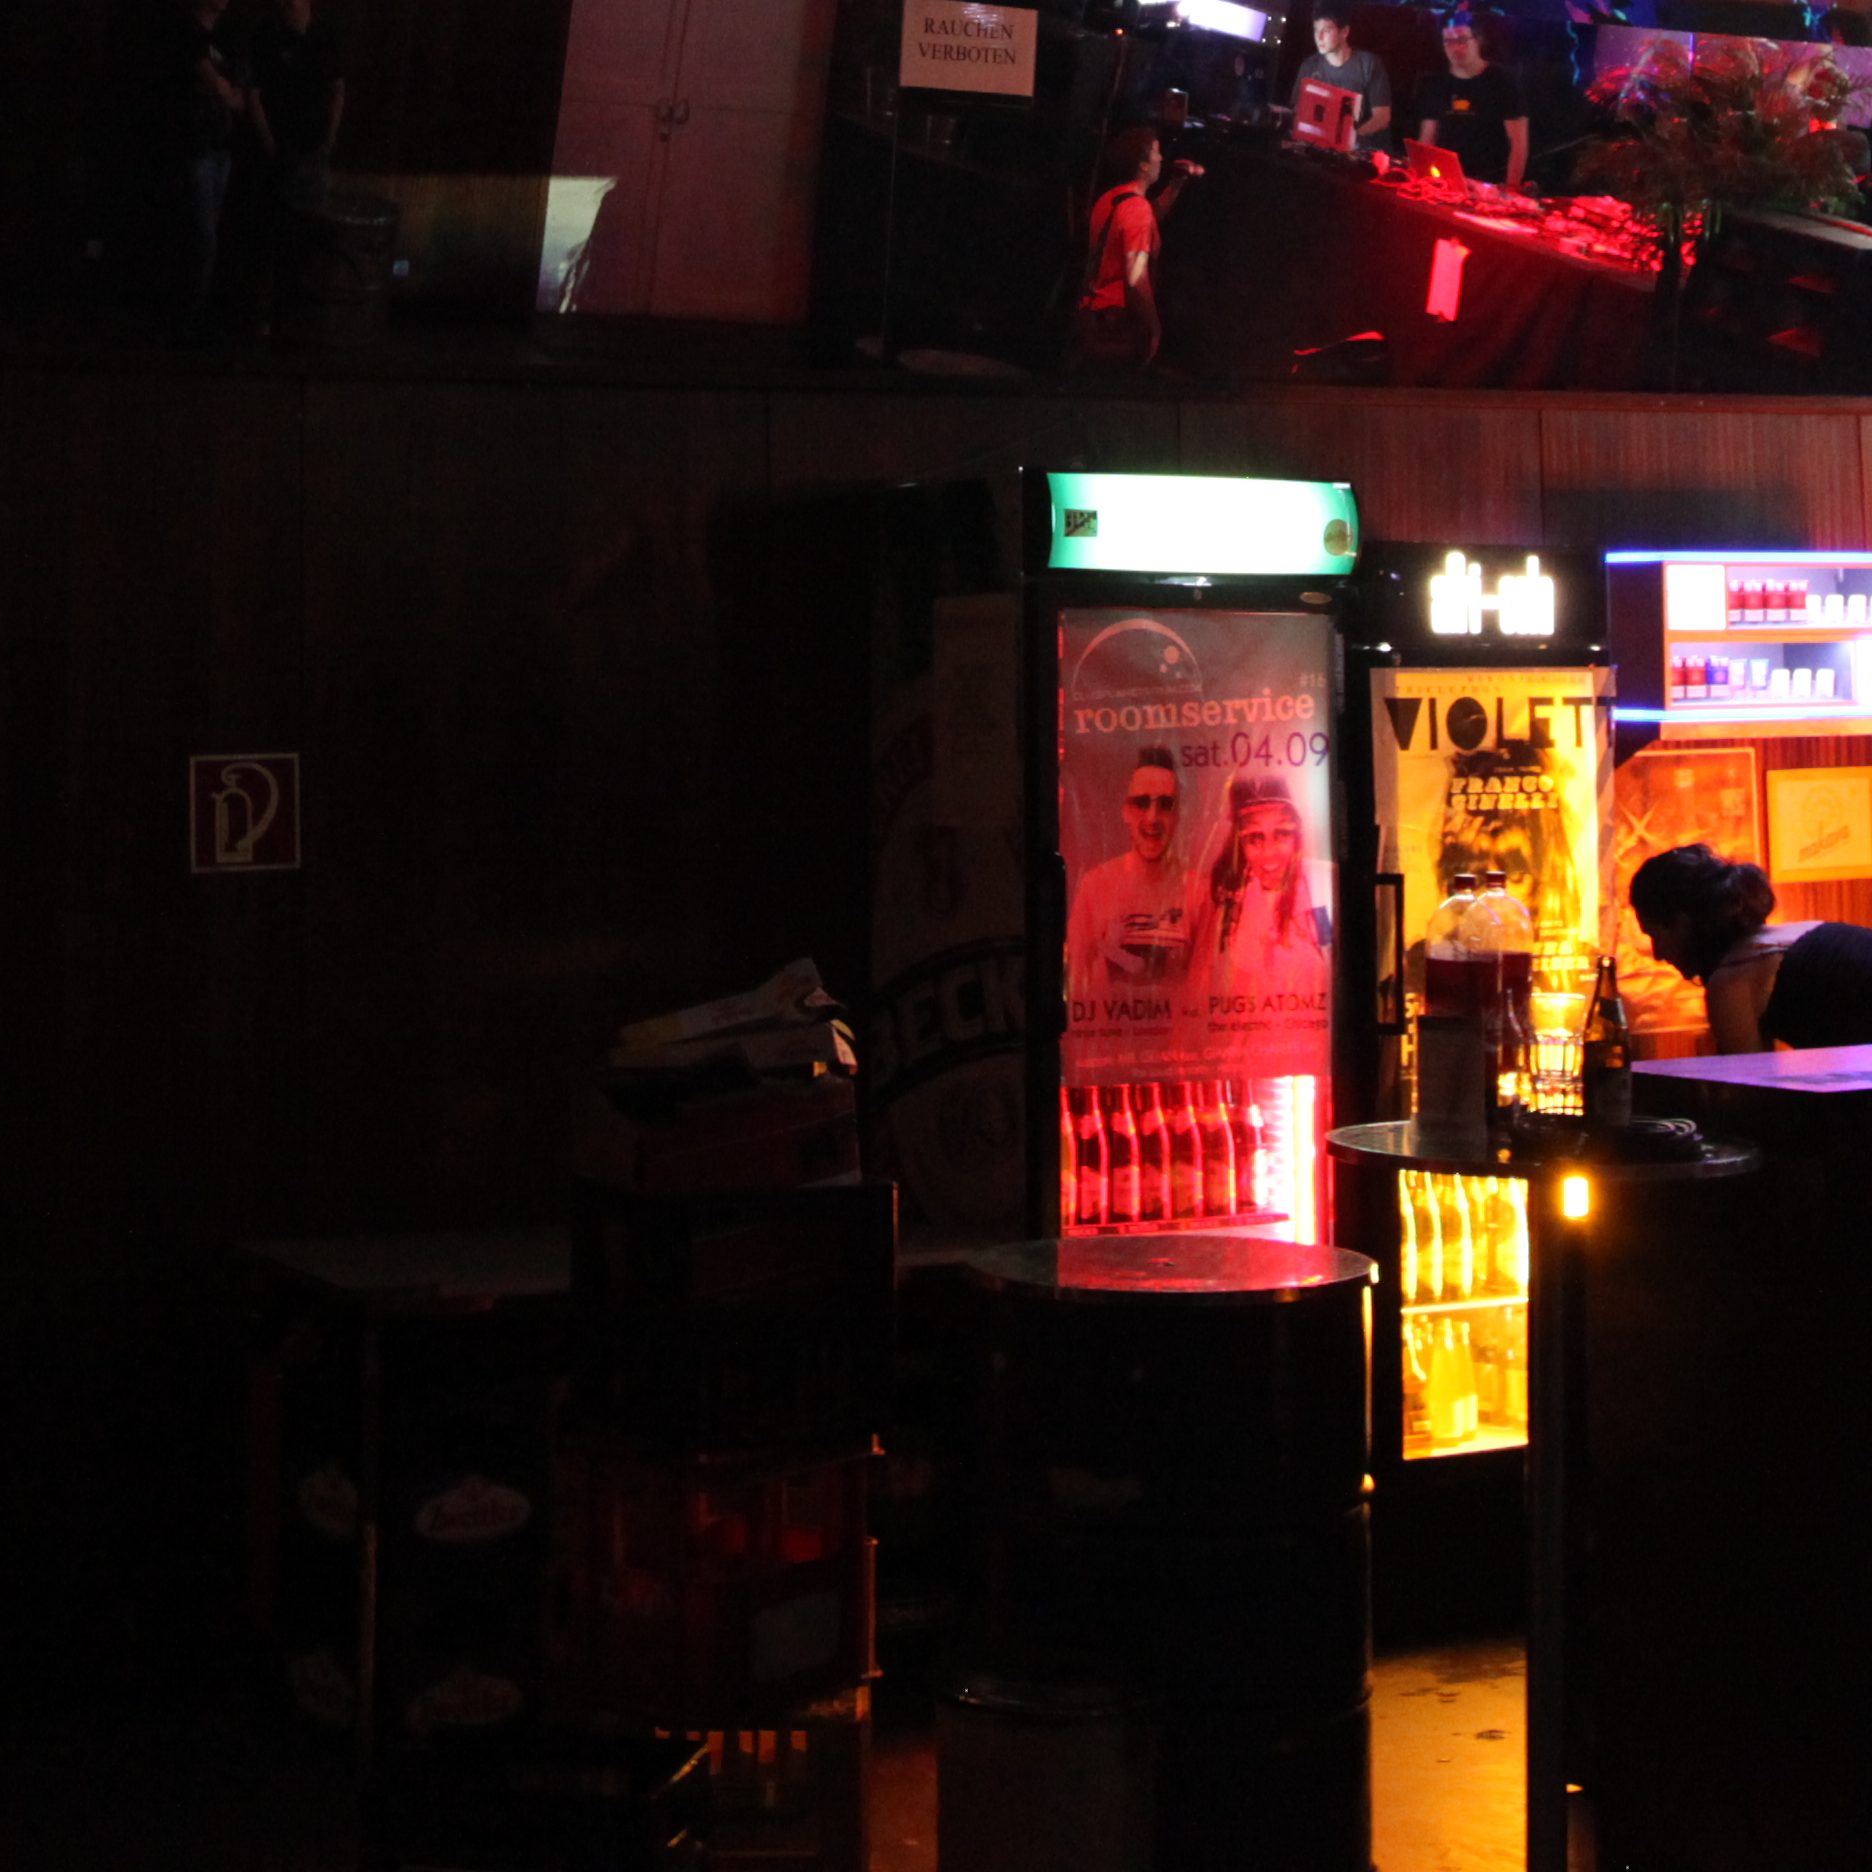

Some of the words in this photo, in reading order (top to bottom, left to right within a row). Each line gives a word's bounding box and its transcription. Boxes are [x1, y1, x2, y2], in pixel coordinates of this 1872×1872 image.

[924, 17, 1015, 40] RAUCHEN
[918, 42, 1017, 65] VERBOTEN
[1073, 687, 1316, 734] roomservice
[1450, 775, 1555, 794] FRANCO
[1072, 1000, 1097, 1023] DJ
[1103, 998, 1172, 1021] VADIM
[1261, 991, 1328, 1013] ATOMZ
